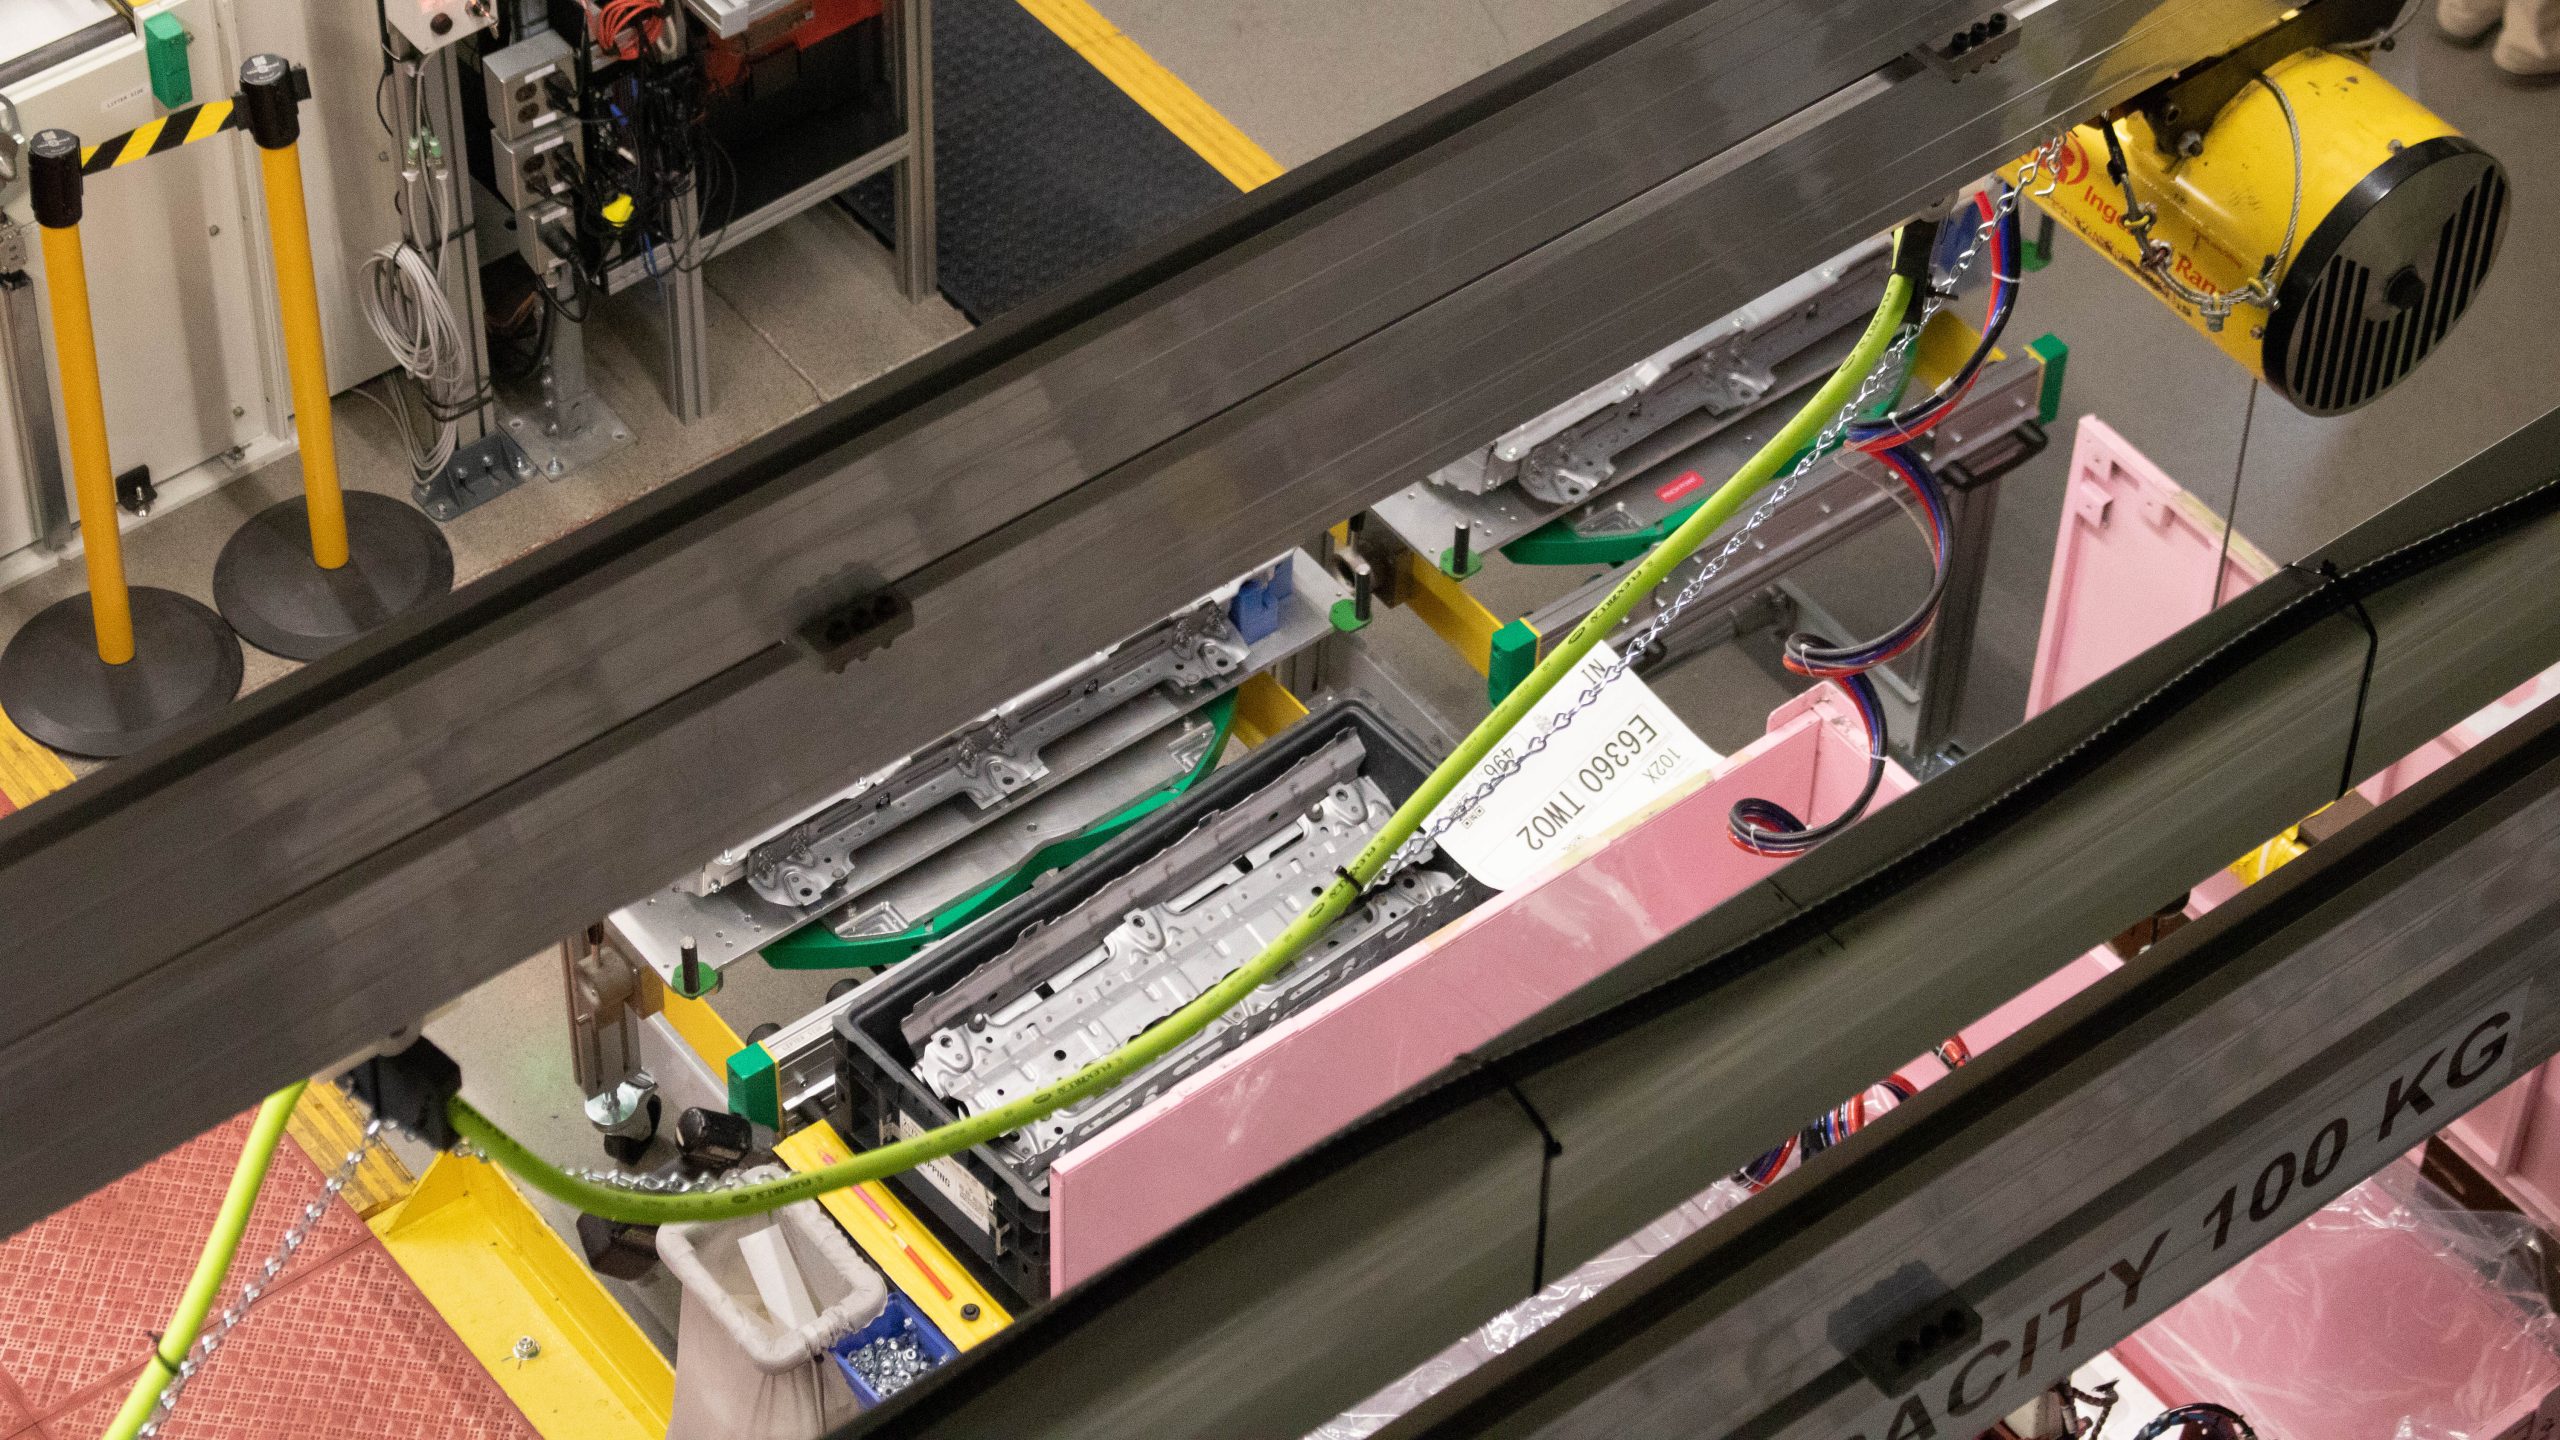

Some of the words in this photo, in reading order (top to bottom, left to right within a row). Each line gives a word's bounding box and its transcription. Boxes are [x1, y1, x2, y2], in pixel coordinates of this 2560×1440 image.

[2175, 254, 2225, 296] Ran
[1483, 746, 1515, 778] 496
[1578, 714, 1657, 793] E6360
[1641, 747, 1682, 784] 102X
[1847, 1229, 2171, 1440] ACITY
[2202, 1116, 2350, 1253] 100
[2375, 1010, 2512, 1141] KG
